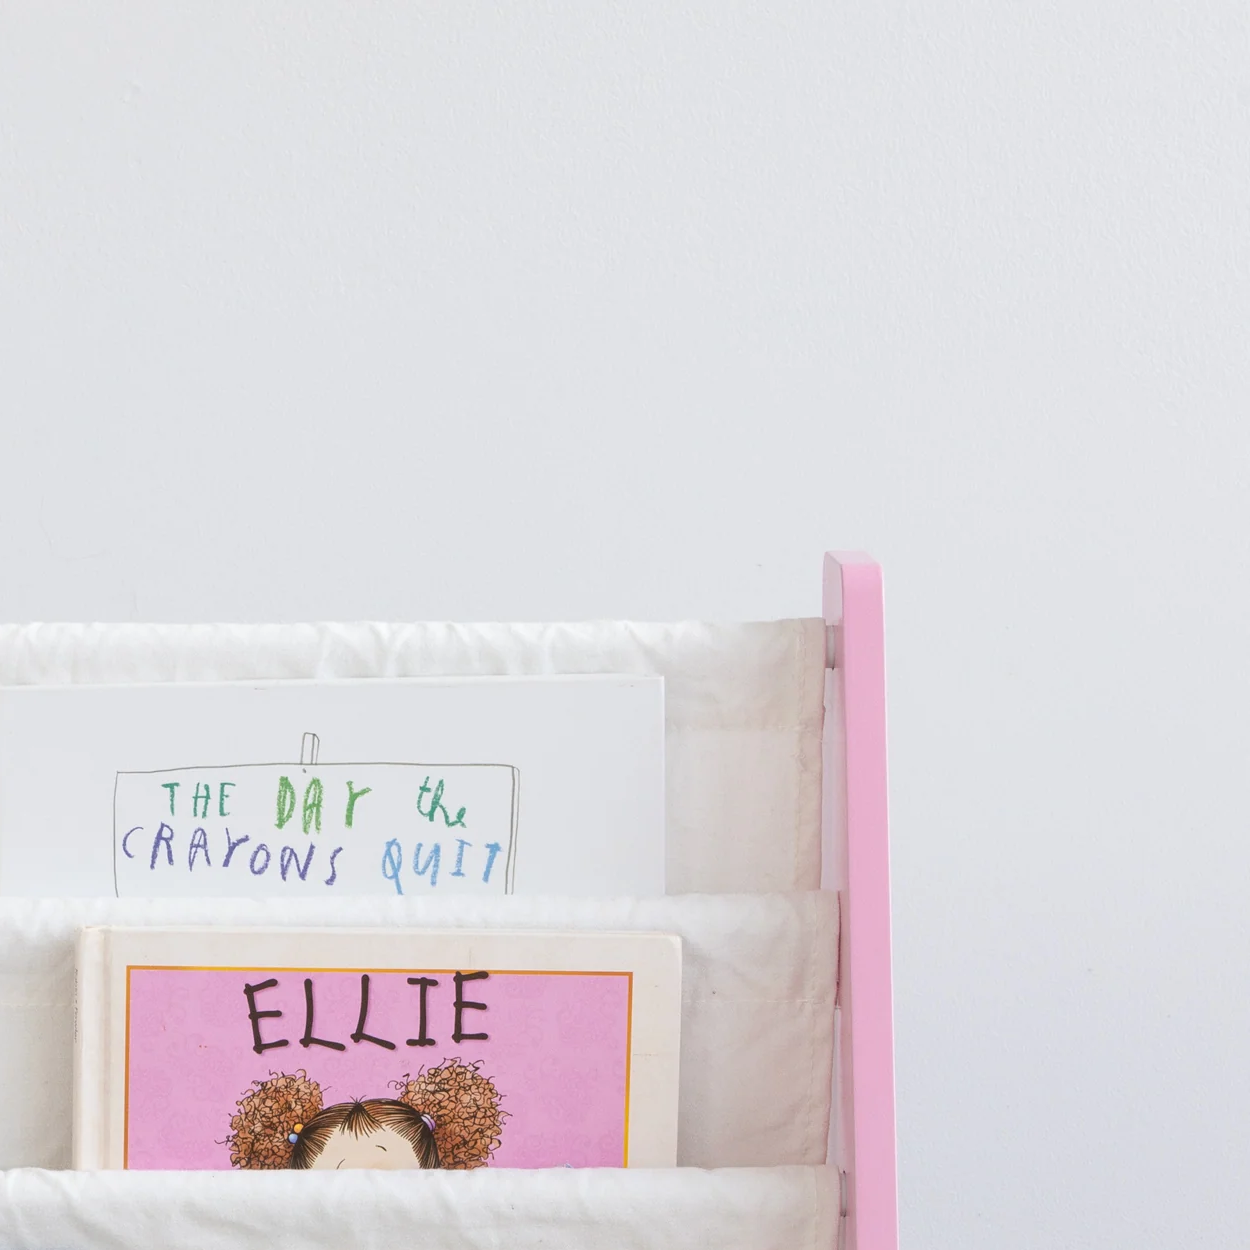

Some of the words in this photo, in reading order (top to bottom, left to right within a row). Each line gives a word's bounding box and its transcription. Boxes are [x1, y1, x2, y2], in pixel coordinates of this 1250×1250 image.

[161, 781, 236, 819] THE
[274, 776, 373, 834] DAY
[416, 776, 467, 828] the
[122, 821, 344, 886] CRAYONS
[382, 837, 502, 895] QUIT
[244, 971, 489, 1053] ELLIE
